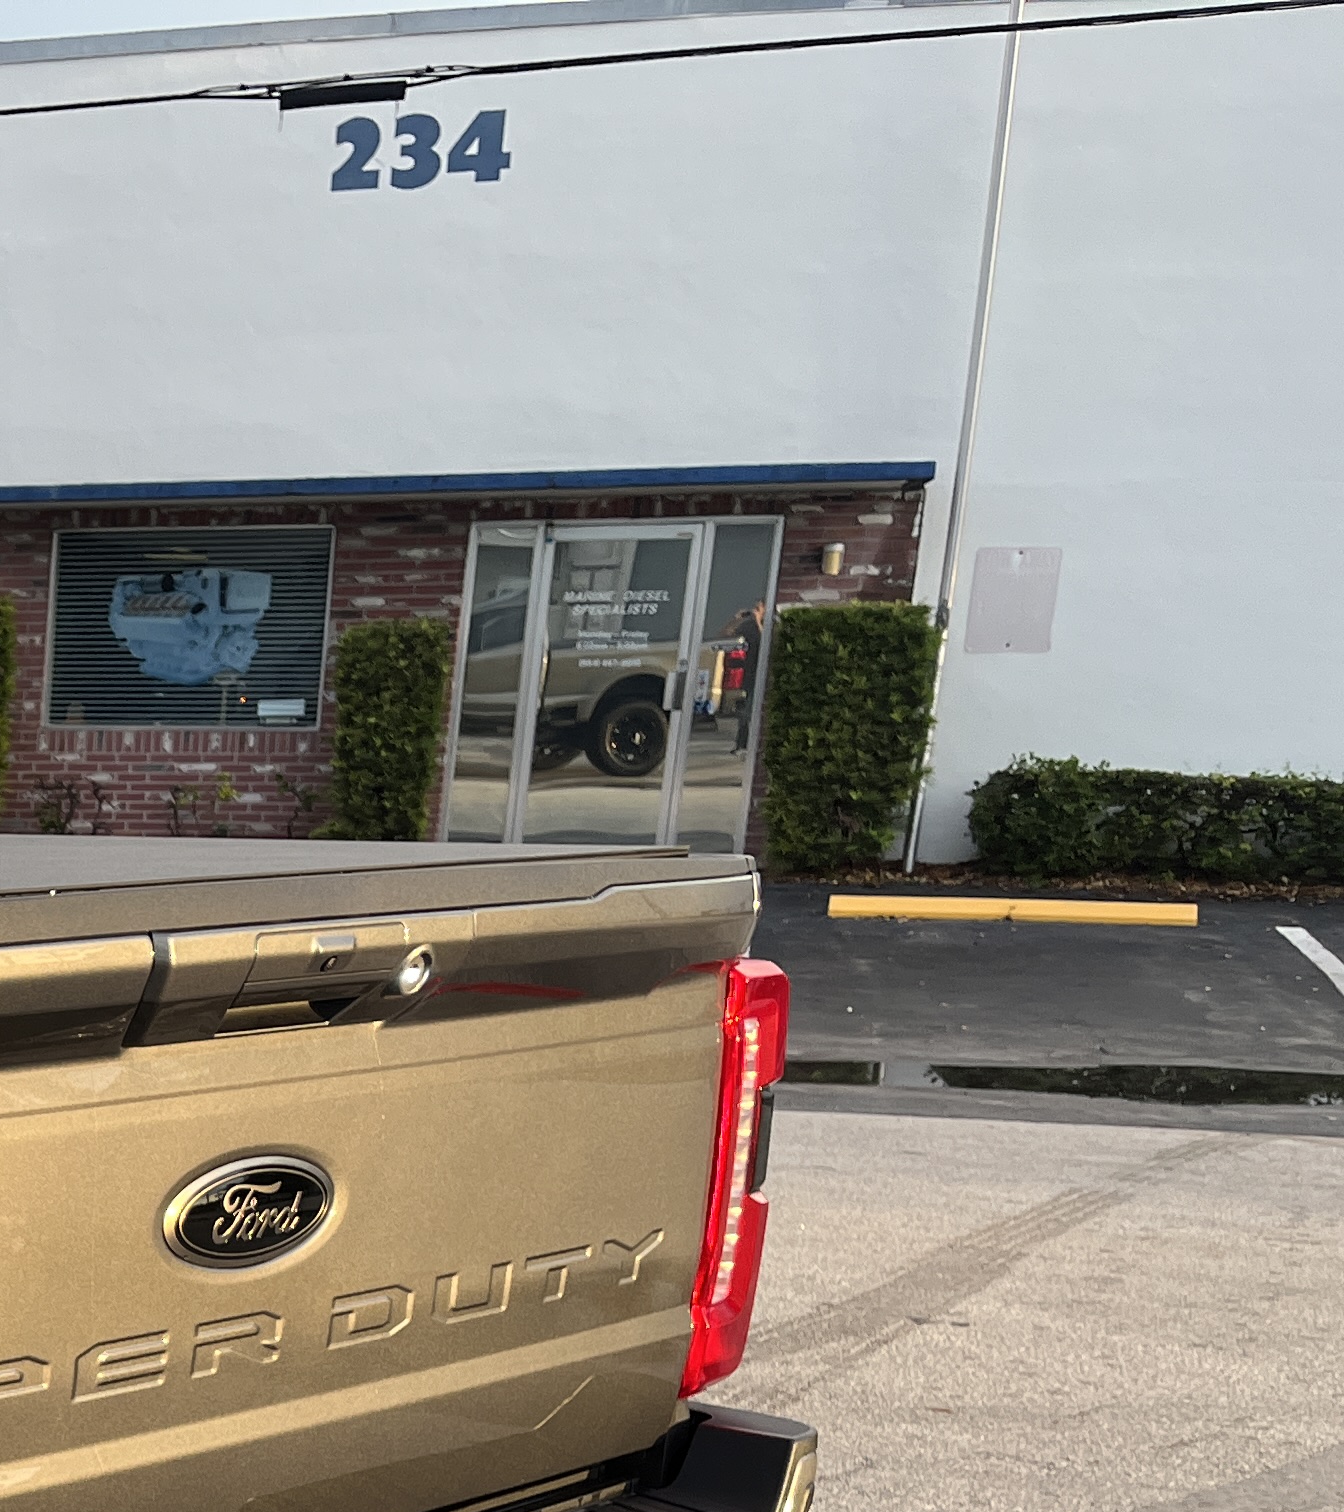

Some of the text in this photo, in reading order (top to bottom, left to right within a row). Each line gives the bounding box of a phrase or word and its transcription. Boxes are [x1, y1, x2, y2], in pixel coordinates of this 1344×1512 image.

[330, 109, 512, 192] 234
[564, 590, 670, 602] MARINE DIESEL
[572, 603, 659, 616] SPECIALISTS
[212, 1180, 303, 1245] Ford
[326, 1227, 665, 1351] DUTY
